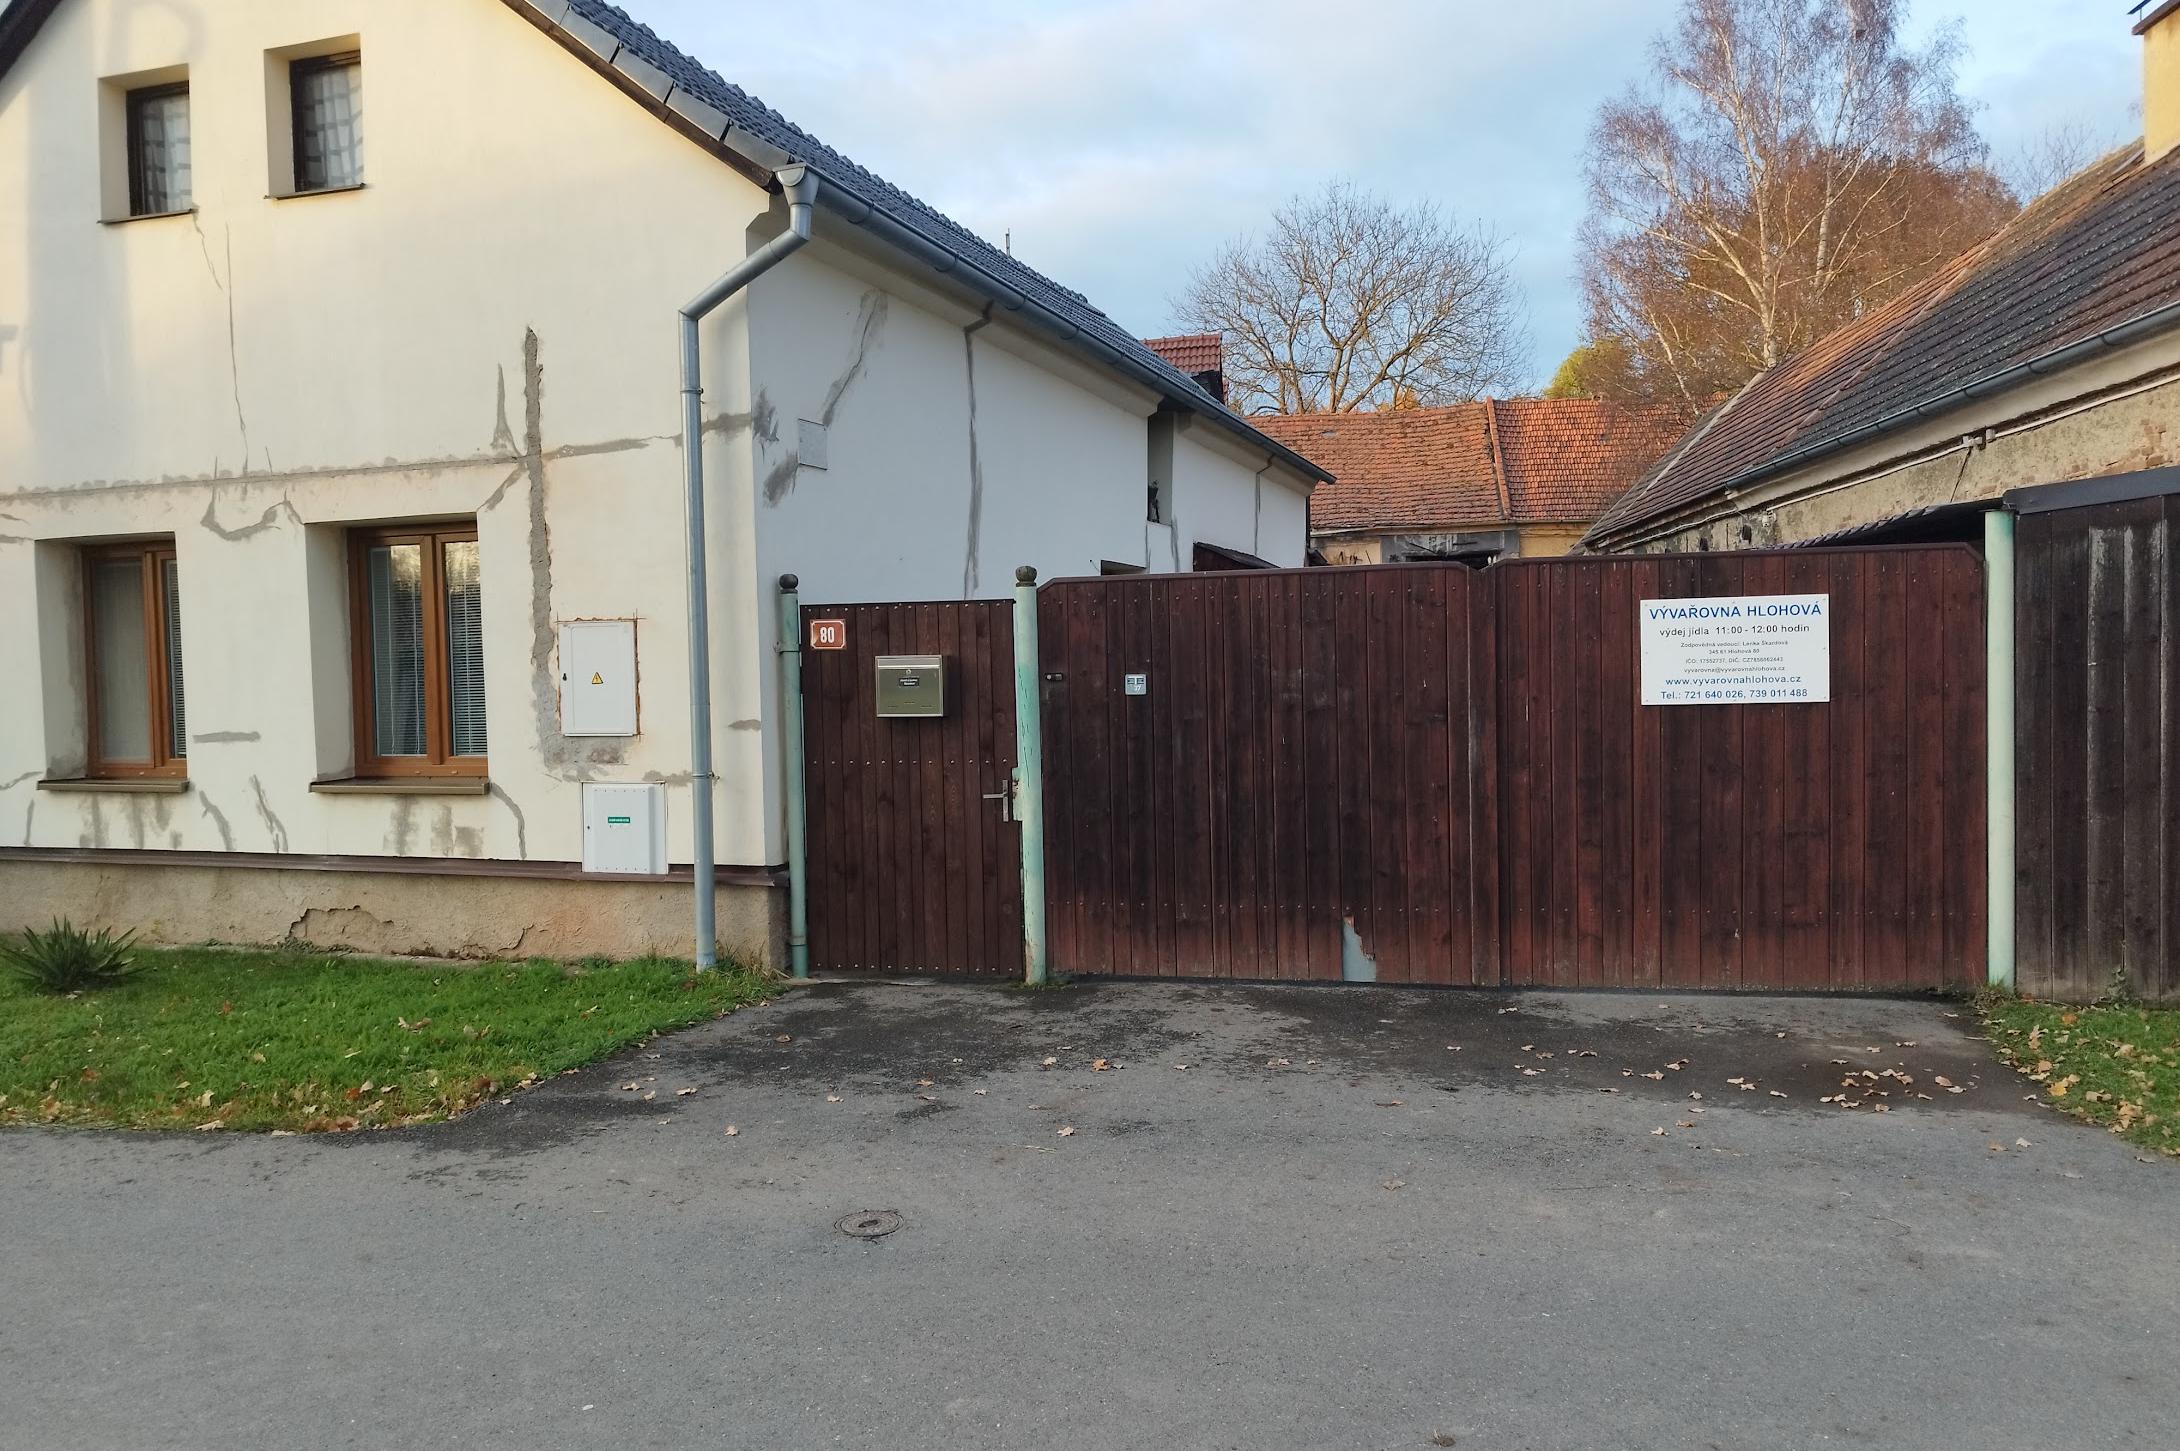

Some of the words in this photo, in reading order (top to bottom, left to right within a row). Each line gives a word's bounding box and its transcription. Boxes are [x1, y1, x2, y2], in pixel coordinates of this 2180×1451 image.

[1649, 604, 1741, 620] VÝVAŘOVNA
[1747, 601, 1822, 617] HLOHOVÁ
[820, 626, 835, 643] 80
[1659, 627, 1685, 638] výdej
[1688, 626, 1709, 637] jídla
[1716, 625, 1742, 634] 11:00
[1752, 624, 1778, 634] 12:00
[1781, 623, 1810, 633] hodin
[1665, 675, 1802, 687] www.vyvarovnahlohova.cz
[1685, 690, 1701, 699] 721
[1705, 690, 1723, 699] 640
[1725, 690, 1746, 700] 026,
[1749, 689, 1767, 698] 739
[1770, 689, 1787, 698] 011
[1789, 688, 1808, 697] 488
